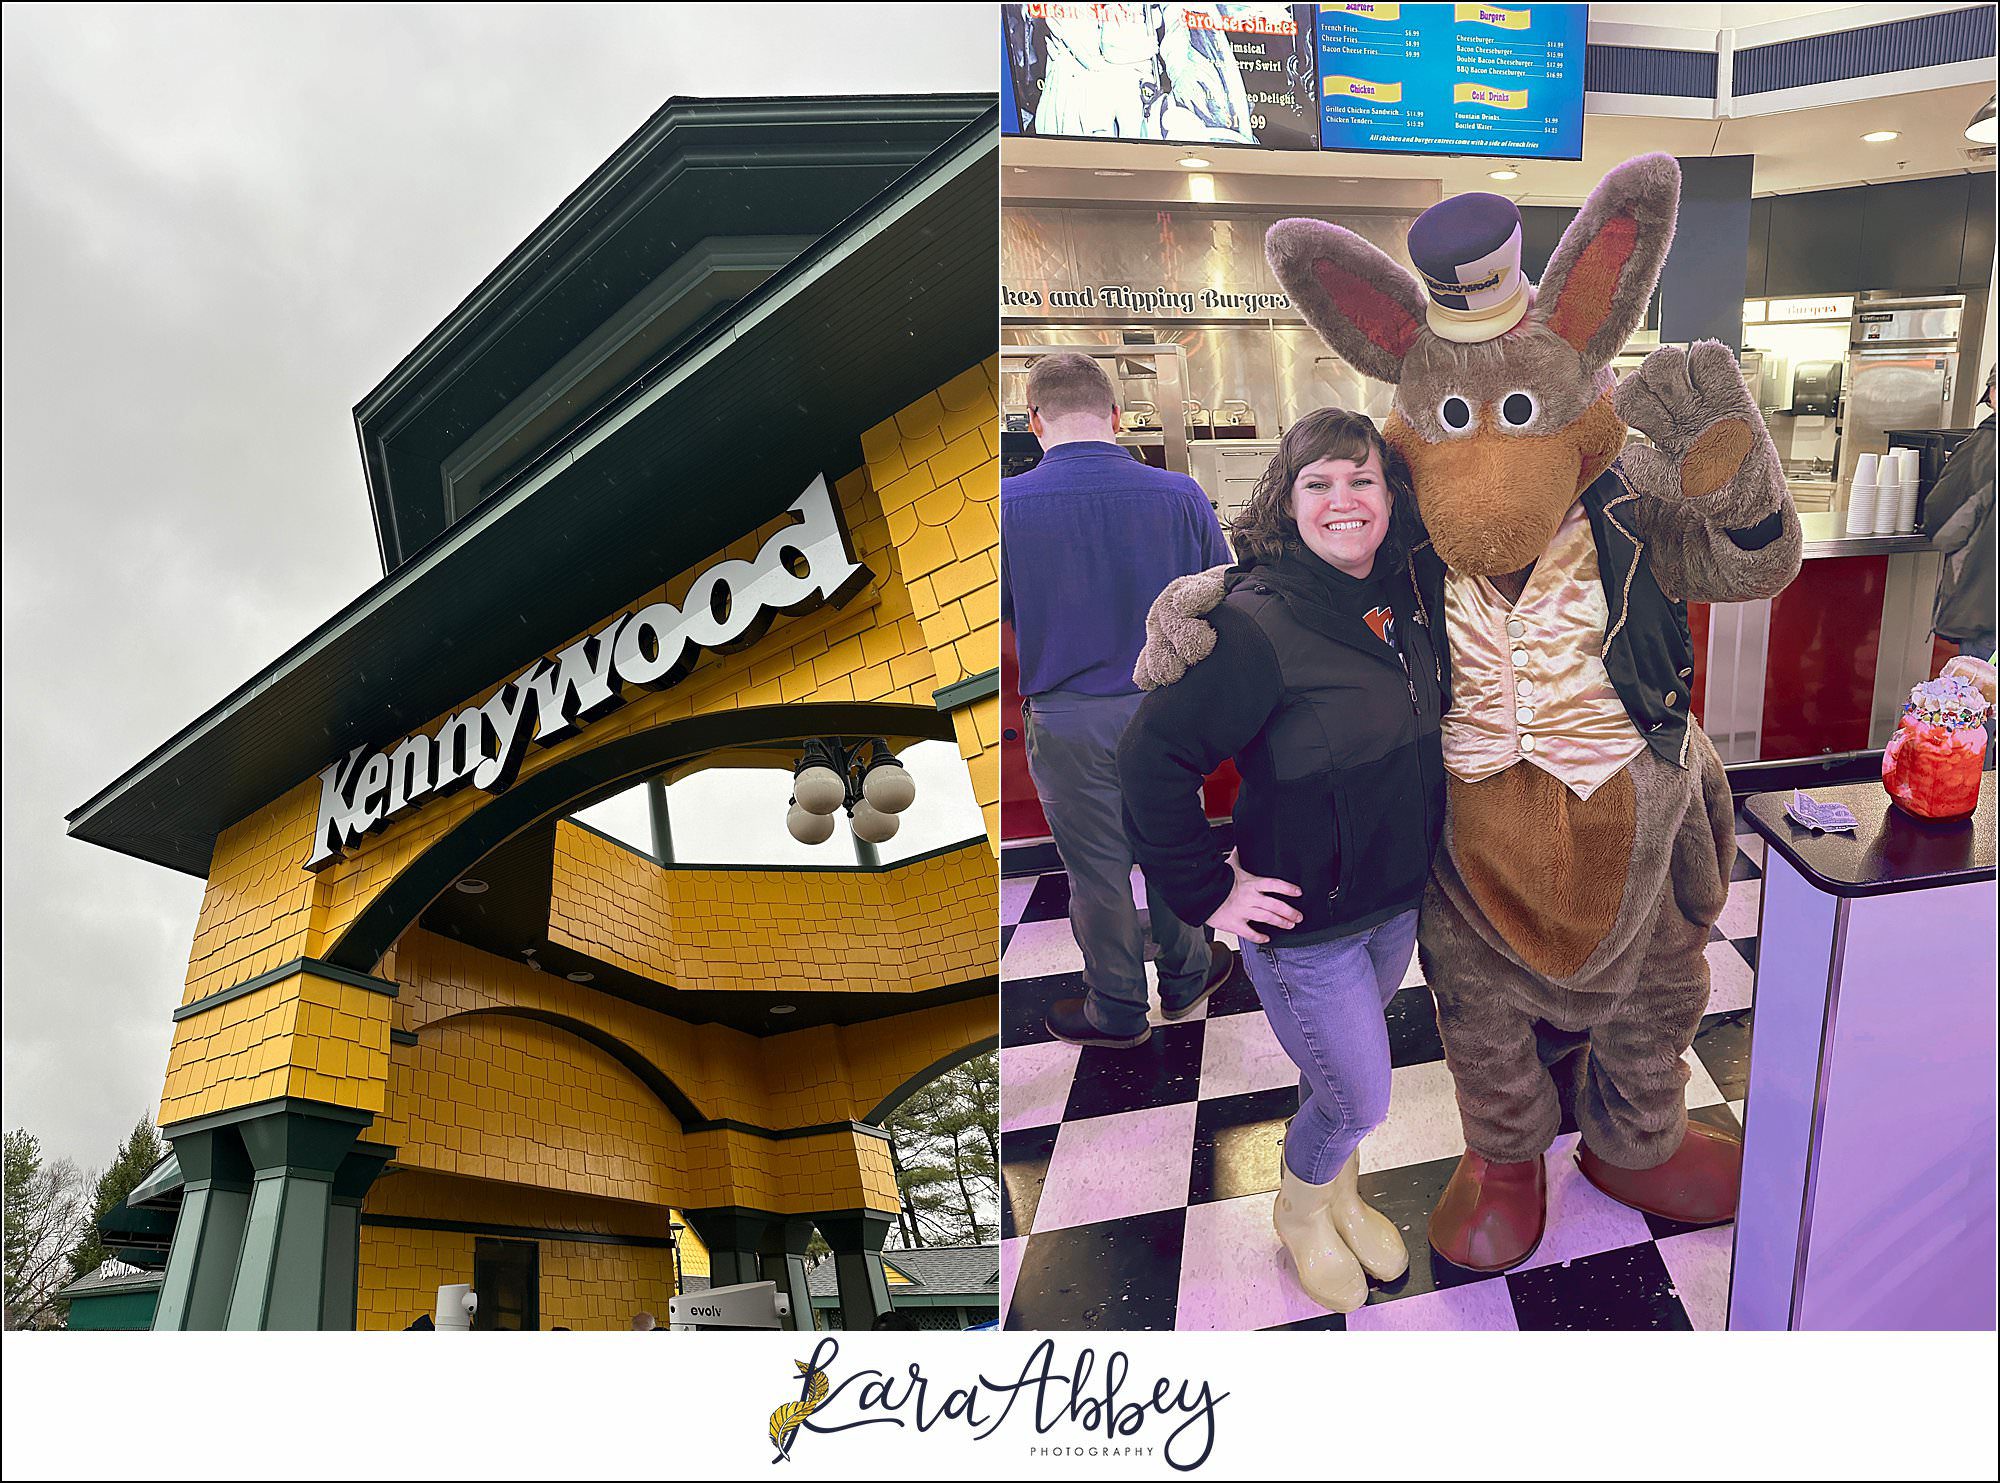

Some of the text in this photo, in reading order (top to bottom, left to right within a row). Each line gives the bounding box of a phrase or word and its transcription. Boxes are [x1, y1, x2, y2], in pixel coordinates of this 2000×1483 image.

[1480, 10, 1506, 22] Burgers
[1321, 24, 1342, 32] French
[1343, 25, 1359, 33] Fries
[1321, 34, 1342, 43] Cheese
[1343, 36, 1359, 44] Fries
[1456, 35, 1495, 44] Cheeseburger
[1322, 45, 1341, 53] Bacon
[1342, 47, 1363, 55] Cheese
[1363, 48, 1379, 56] Fries
[1456, 45, 1475, 53] Bacon
[1475, 47, 1513, 56] Cheeseburger
[1255, 61, 1282, 73] Swirl
[1477, 57, 1496, 65] Bacon
[1496, 58, 1534, 68] Cheeseburger
[1456, 66, 1470, 75] BBQ
[1470, 67, 1488, 75] Bacon
[1488, 68, 1526, 78] Cheeseburger
[1349, 84, 1375, 95] Chicken
[1259, 92, 1296, 106] Delight
[1471, 90, 1510, 103] Cold Drinks
[1325, 105, 1346, 113] Grilled
[1346, 106, 1371, 115] Chicken
[1371, 107, 1399, 116] Sandwich
[1326, 115, 1352, 124] Chicken
[1351, 116, 1373, 125] Tenders
[1455, 112, 1481, 120] Fountain
[1481, 113, 1500, 121] Drinks
[1455, 122, 1476, 130] Bottled
[1476, 123, 1493, 131] Water
[1414, 136, 1434, 144] burger
[1001, 284, 1292, 314] kes and Flipping Burgers
[304, 471, 862, 870] Kennywood
[690, 1305, 722, 1317] evolv
